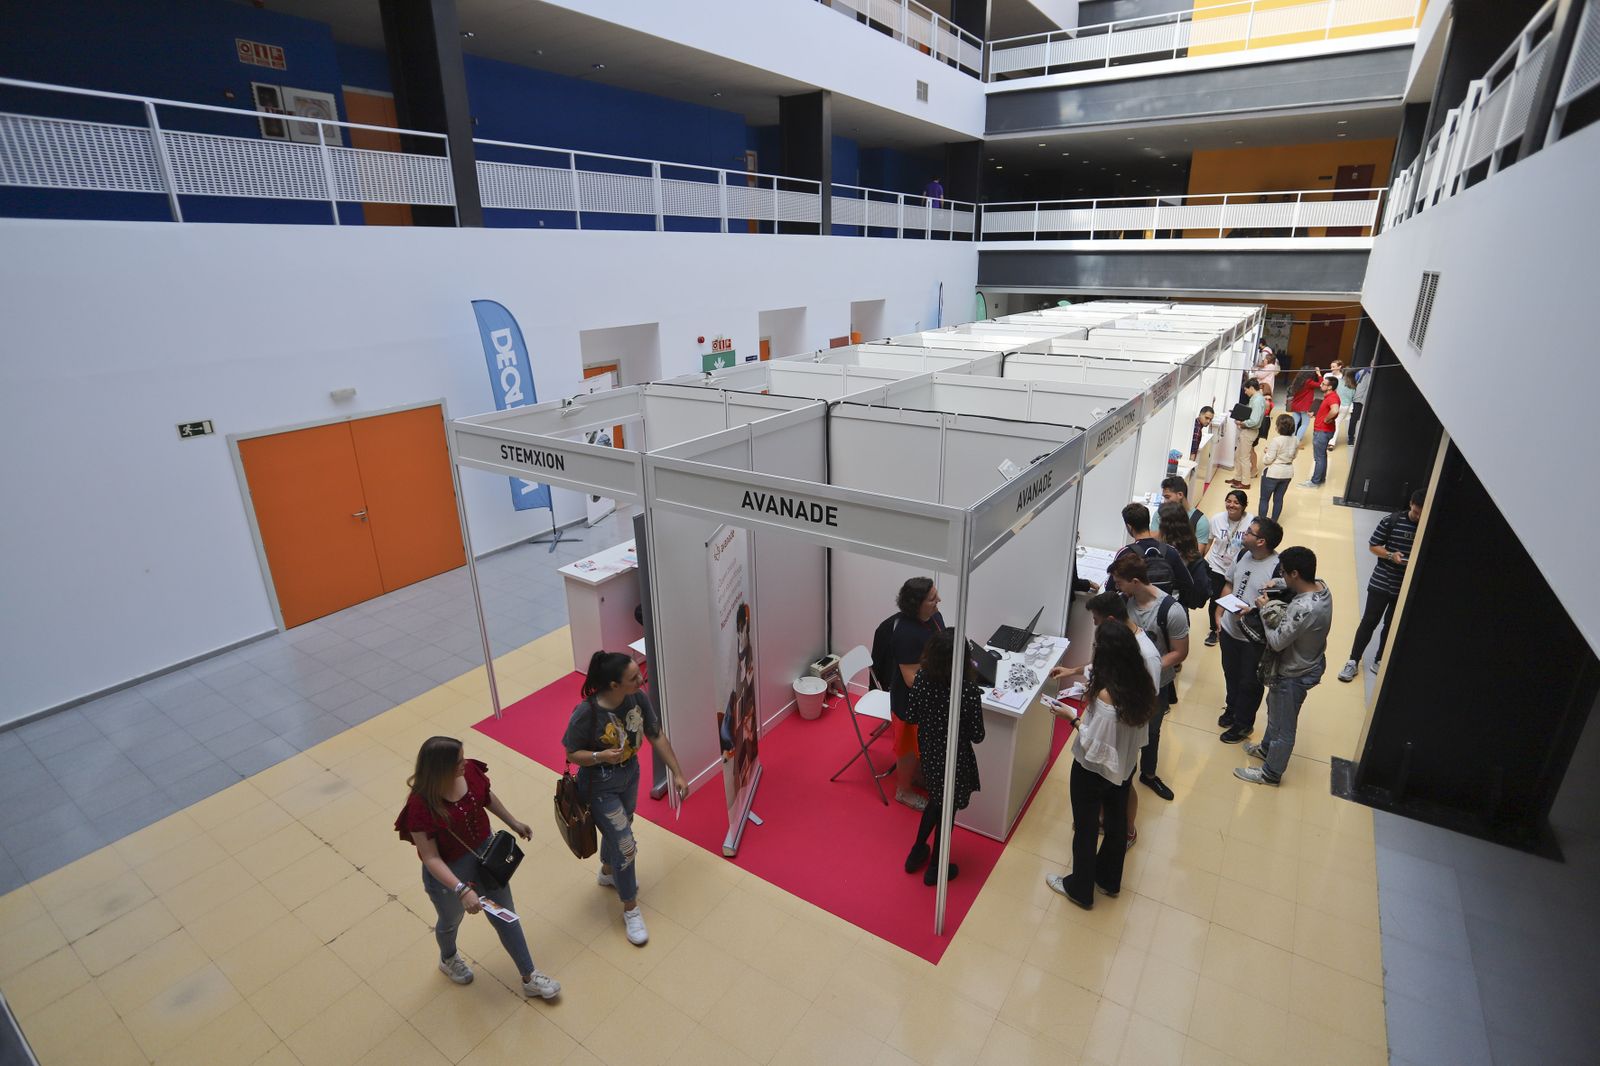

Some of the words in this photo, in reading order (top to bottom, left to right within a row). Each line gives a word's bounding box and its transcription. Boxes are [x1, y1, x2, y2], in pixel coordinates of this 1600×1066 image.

[1113, 408, 1136, 437] SOLUTIONS
[500, 444, 565, 471] STEMXION
[1016, 470, 1053, 512] AVANADE
[741, 490, 838, 527] AVANADE
